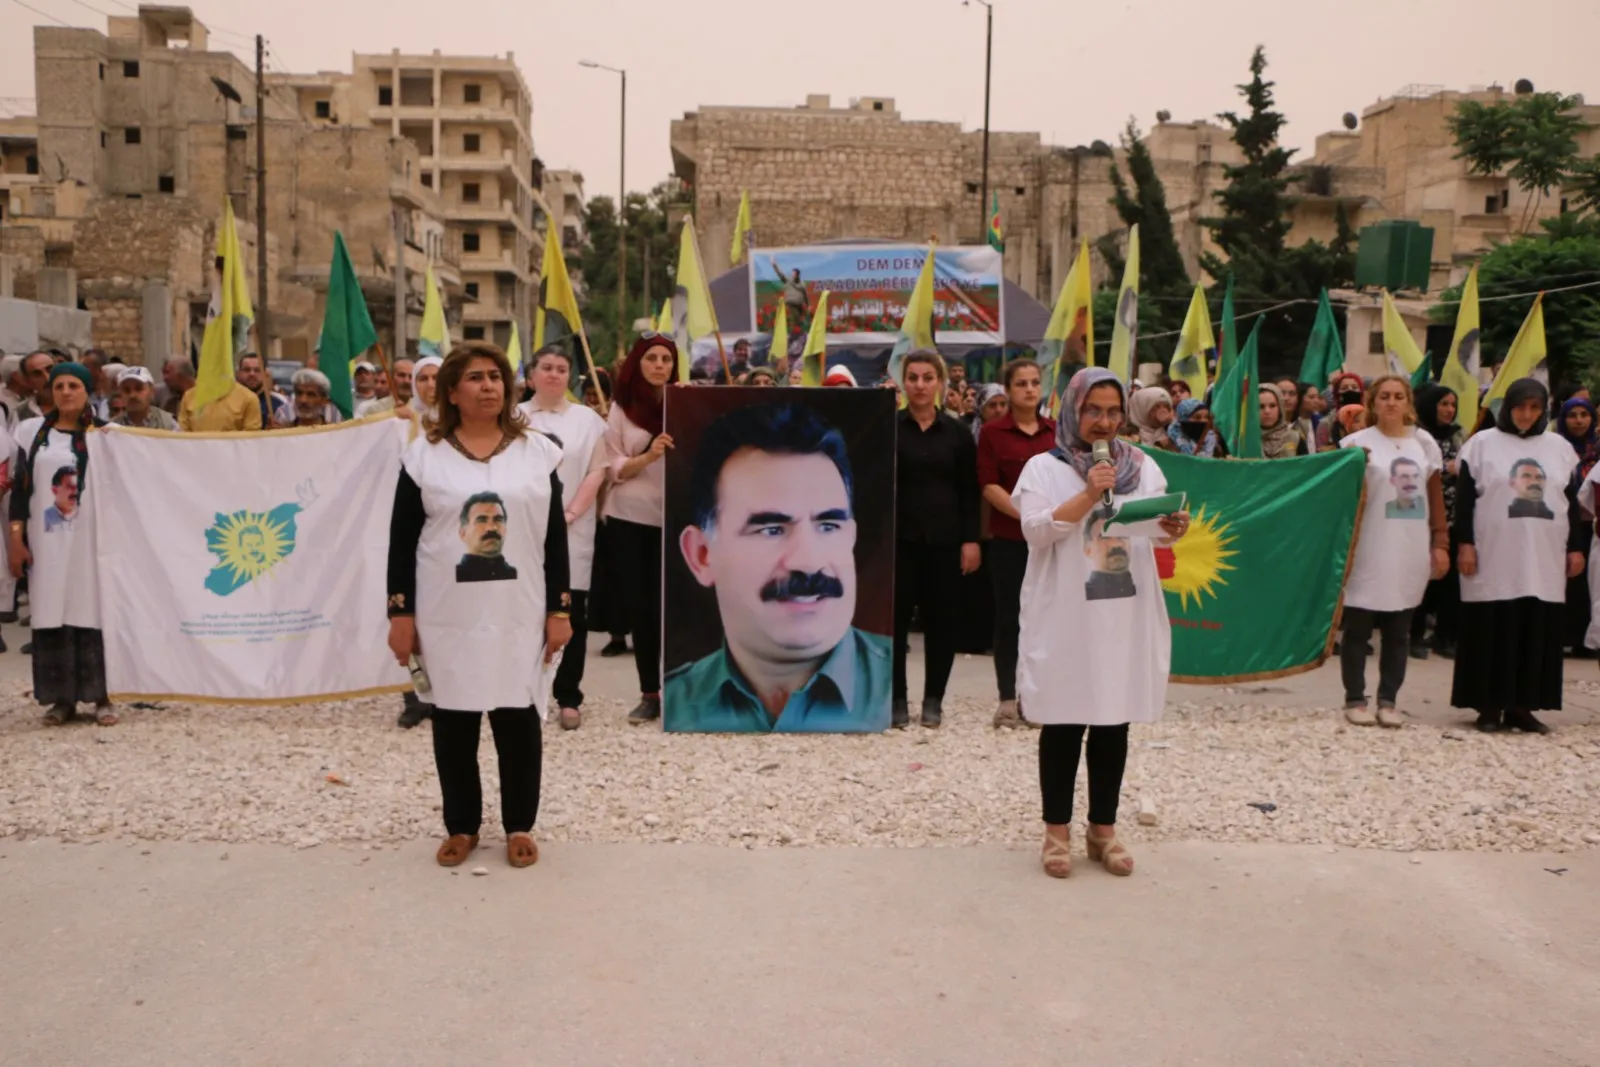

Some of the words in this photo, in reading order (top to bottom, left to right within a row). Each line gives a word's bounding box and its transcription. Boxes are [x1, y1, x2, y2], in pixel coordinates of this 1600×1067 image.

[857, 258, 890, 271] DEM
[815, 278, 878, 291] AZADIYA
[883, 276, 917, 290] RÊBE
